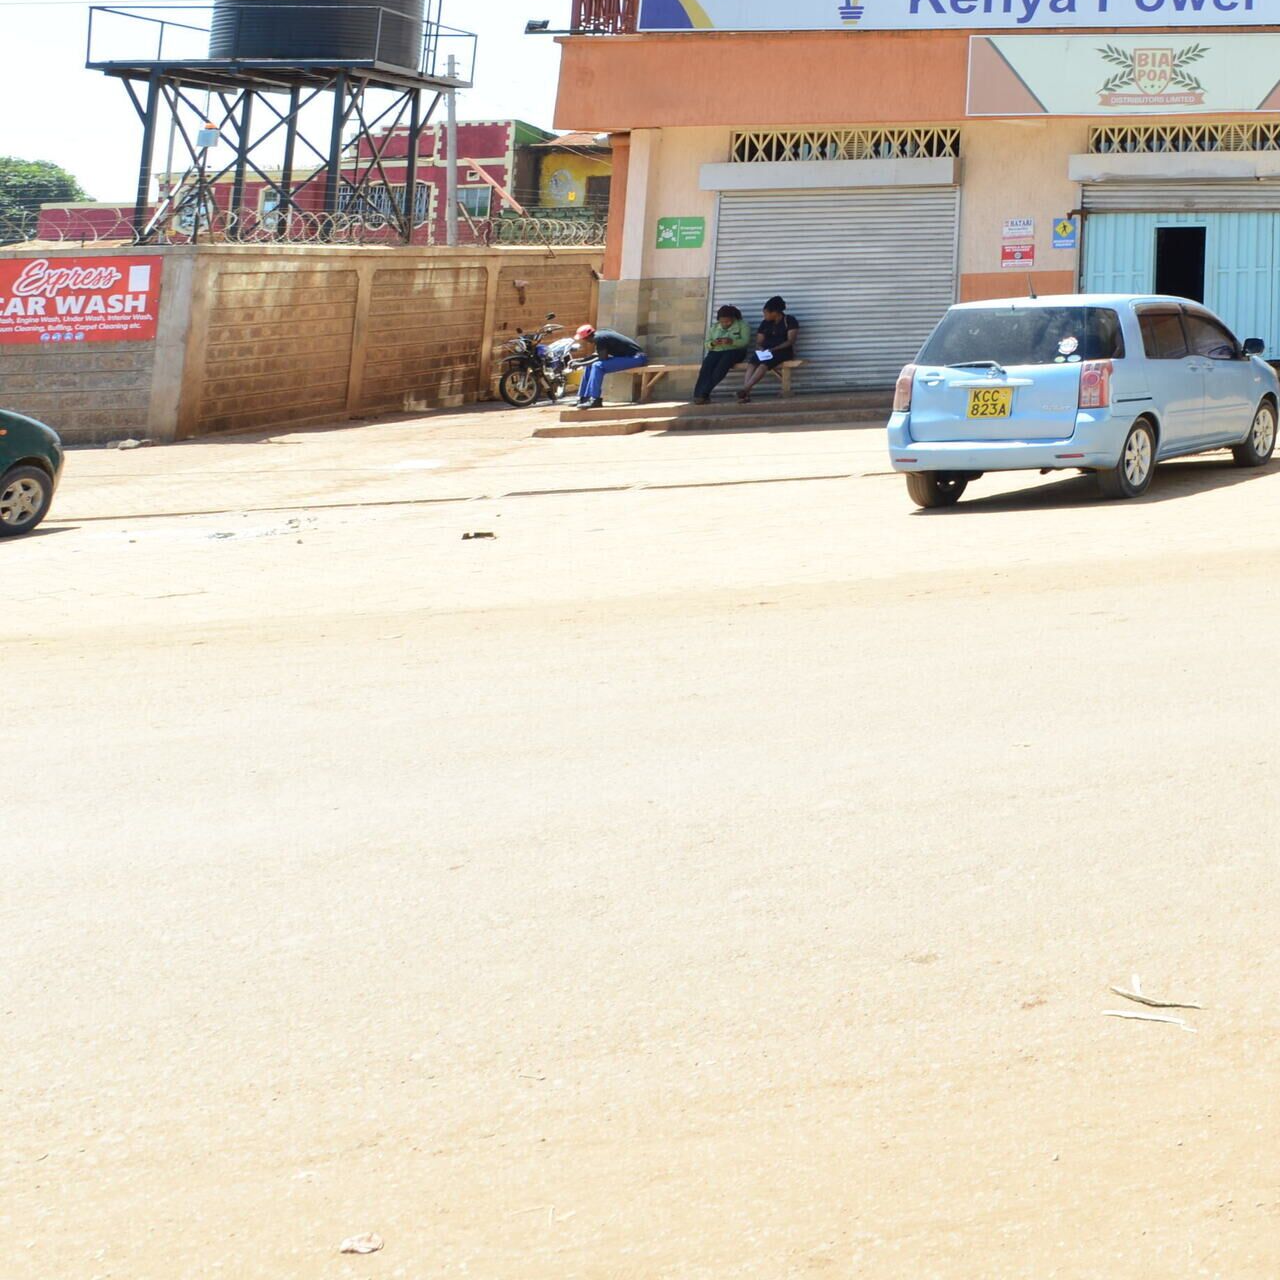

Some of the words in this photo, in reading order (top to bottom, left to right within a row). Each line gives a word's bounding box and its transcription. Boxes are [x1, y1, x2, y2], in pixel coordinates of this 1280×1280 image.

[1137, 52, 1170, 68] BIA
[1137, 69, 1168, 81] POA
[1110, 96, 1165, 104] DISTRIBUTORS
[1166, 95, 1195, 103] LIMITED
[12, 259, 122, 298] Express
[55, 294, 147, 315] WASH
[74, 323, 98, 331] Carpet
[99, 322, 128, 330] Cleaning
[973, 389, 1000, 403] KCC
[970, 403, 1006, 416] 823A
